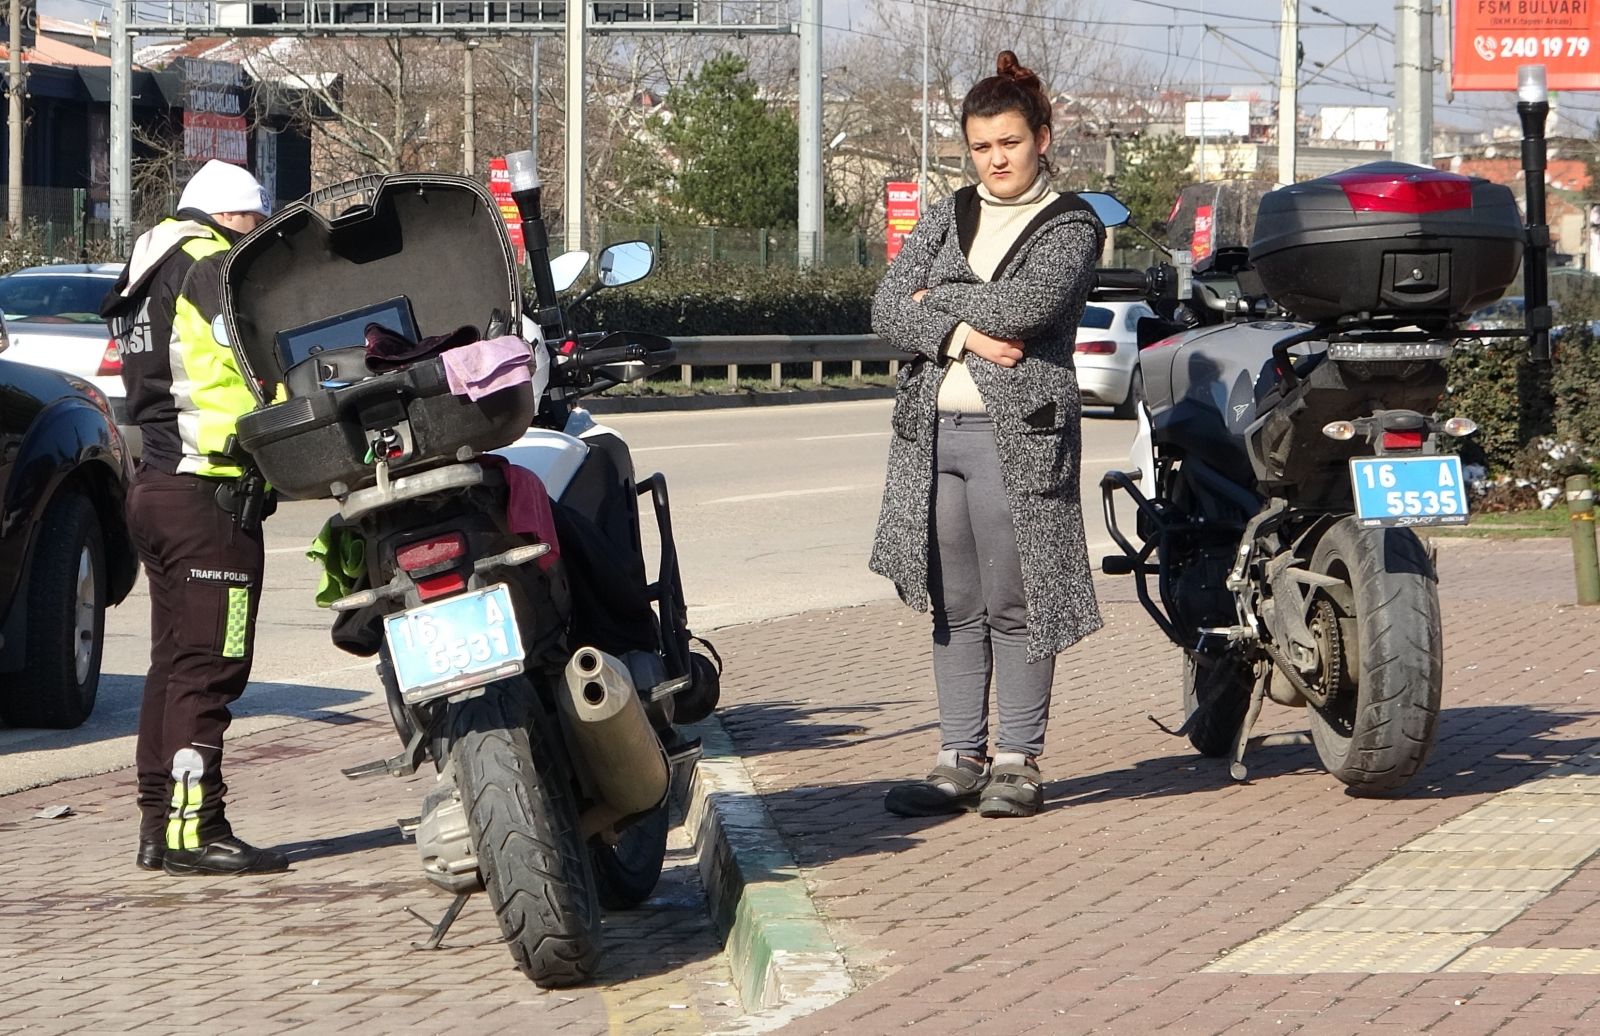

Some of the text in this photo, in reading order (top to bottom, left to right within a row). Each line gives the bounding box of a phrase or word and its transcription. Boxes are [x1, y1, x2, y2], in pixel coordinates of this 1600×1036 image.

[1478, 1, 1587, 14] FSM BULVARI
[1501, 36, 1590, 57] 240 19 79
[1363, 462, 1455, 489] 16 A
[1386, 490, 1458, 515] 5535
[398, 594, 505, 648] 16 A
[428, 627, 509, 673] 5531
